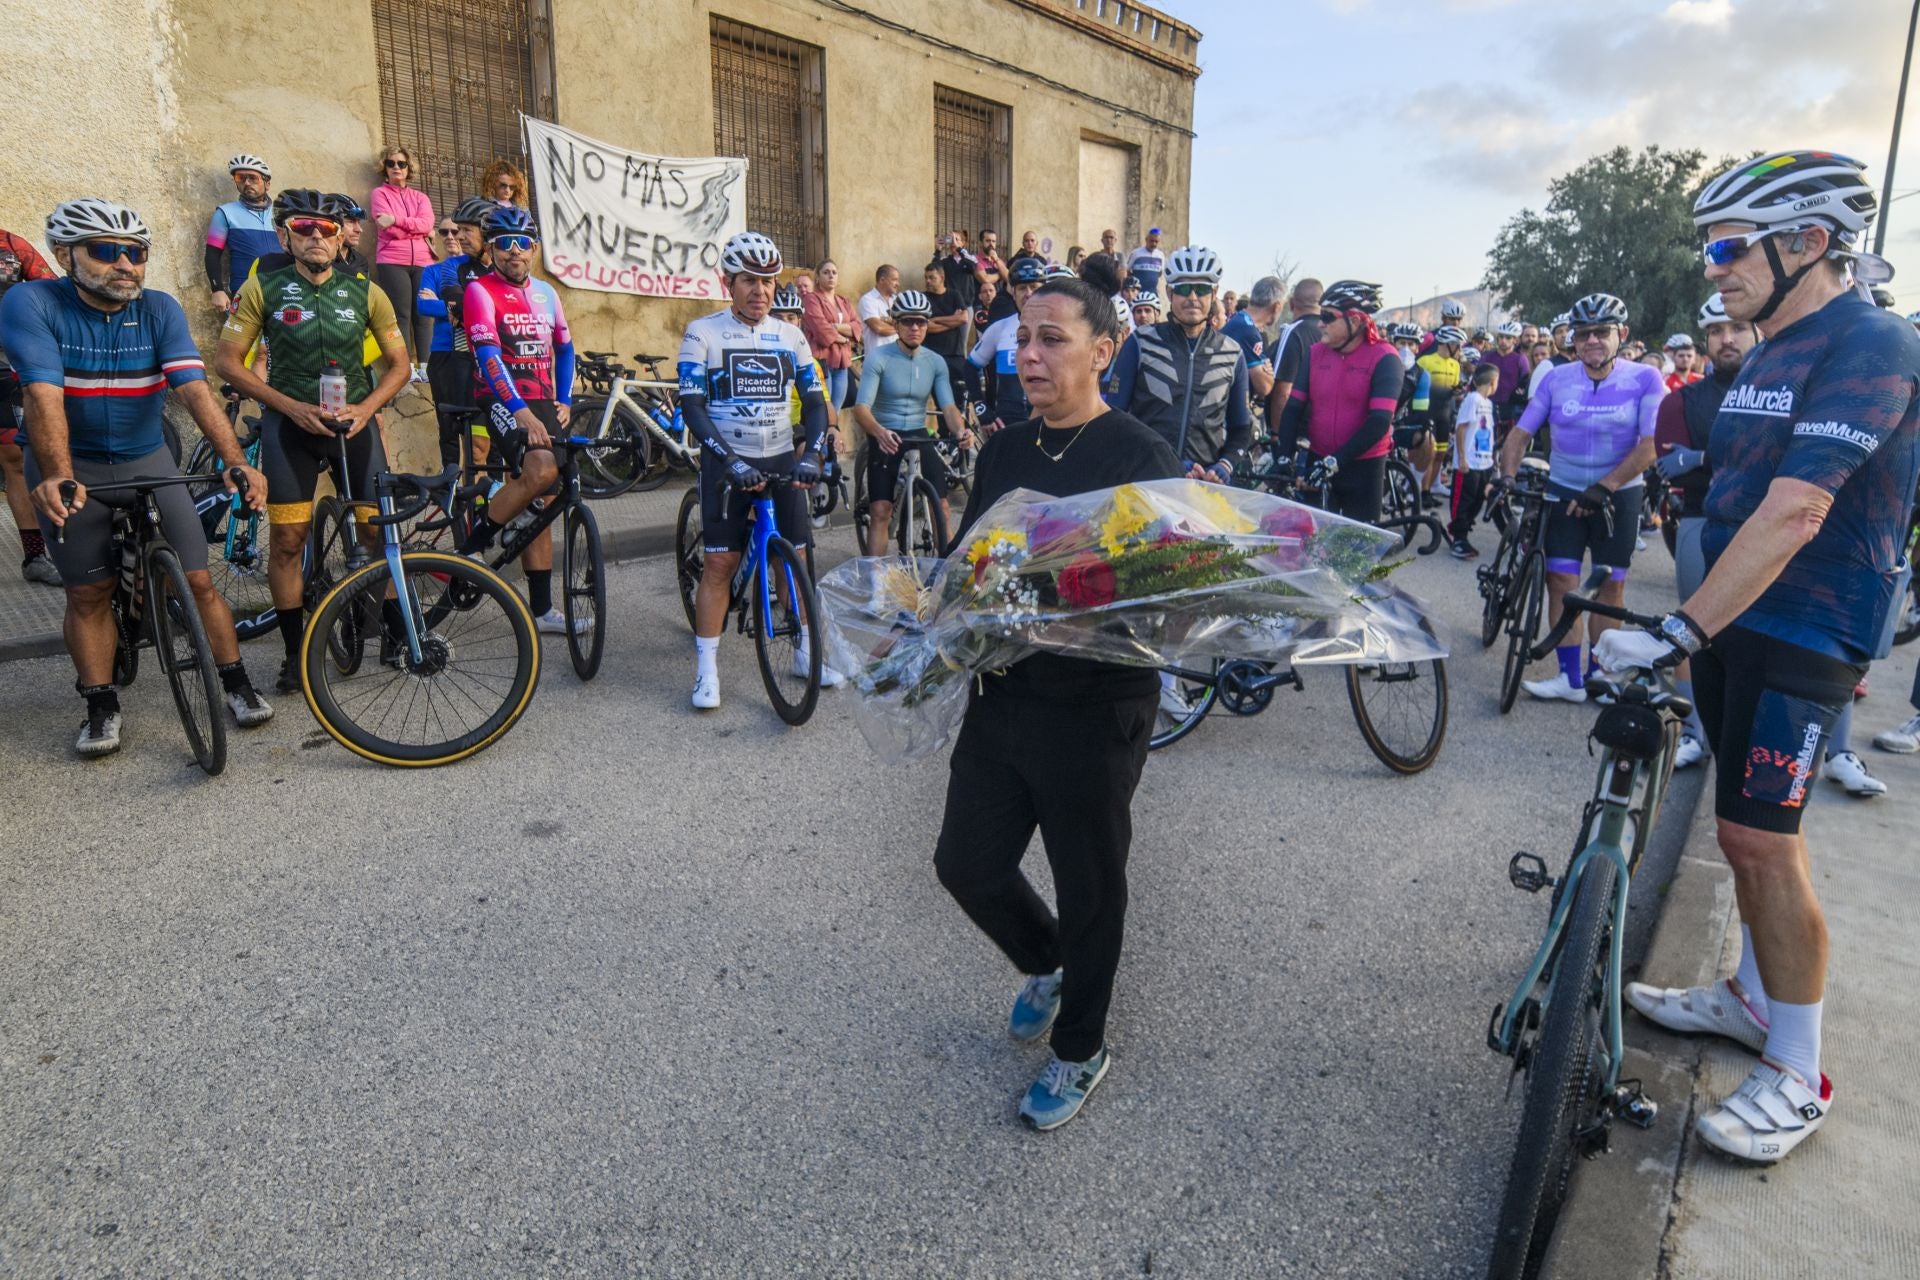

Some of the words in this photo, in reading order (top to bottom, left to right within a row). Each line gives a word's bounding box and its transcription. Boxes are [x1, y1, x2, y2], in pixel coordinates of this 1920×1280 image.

[546, 137, 606, 193] NO
[621, 154, 689, 210] MÁS
[552, 201, 720, 275] MUERTO
[737, 377, 777, 386] Ricardo
[737, 385, 777, 394] Fuentes
[490, 411, 509, 437] VICEA
[491, 402, 519, 431] CICLOS
